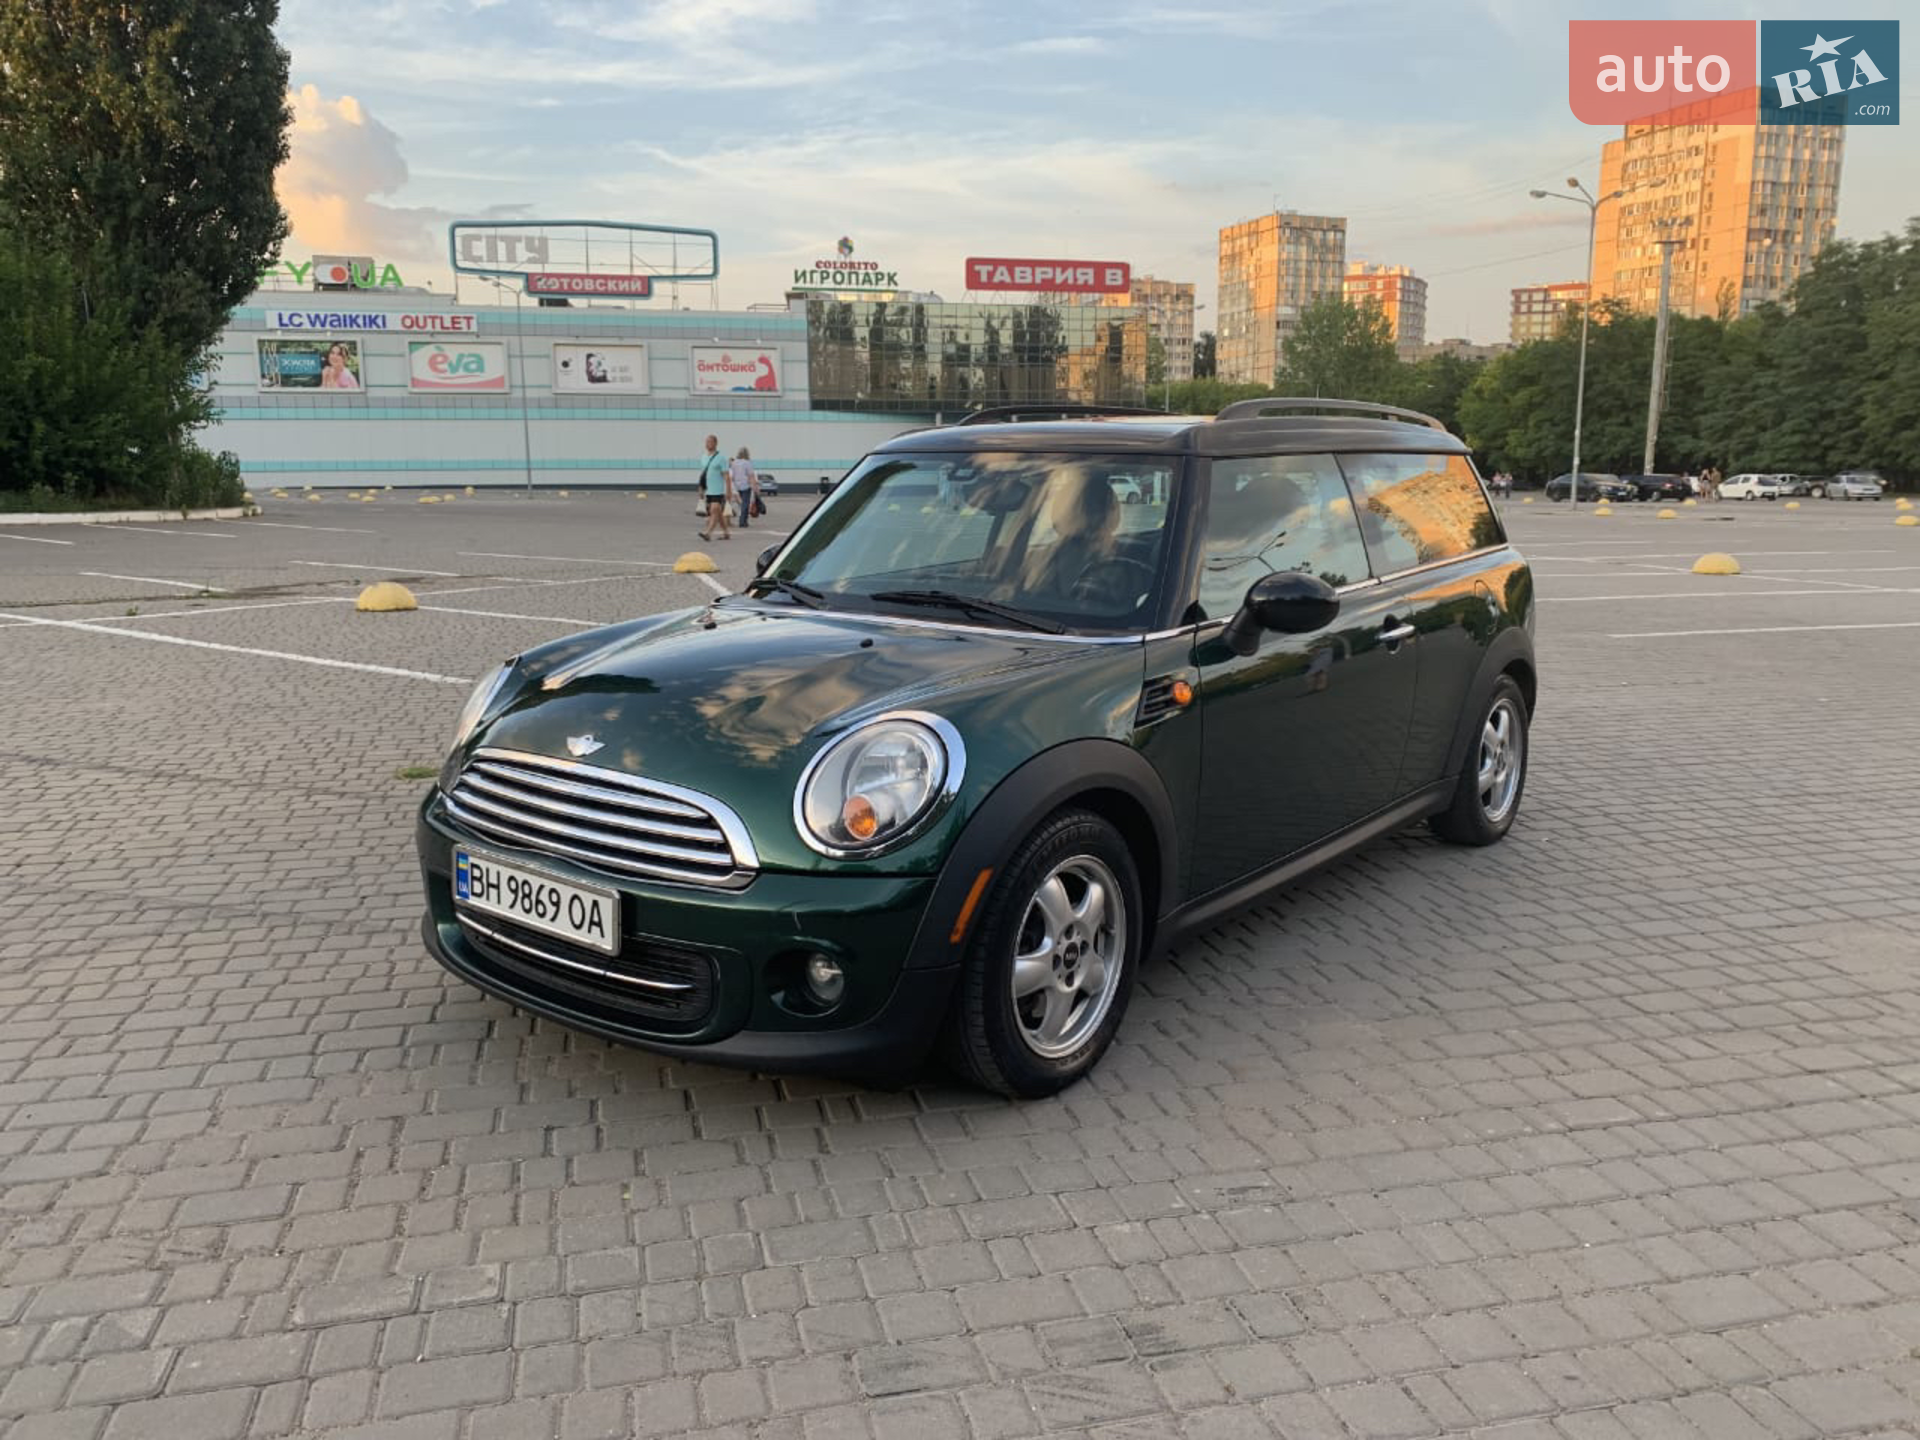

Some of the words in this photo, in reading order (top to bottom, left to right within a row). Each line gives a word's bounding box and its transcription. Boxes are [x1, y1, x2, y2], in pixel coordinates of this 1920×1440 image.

[793, 268, 899, 287] ИГРОПАРК
[974, 264, 1095, 285] ТАВРИЯ
[277, 311, 303, 328] LC
[401, 314, 474, 331] OUTLET
[506, 874, 561, 923] 9869
